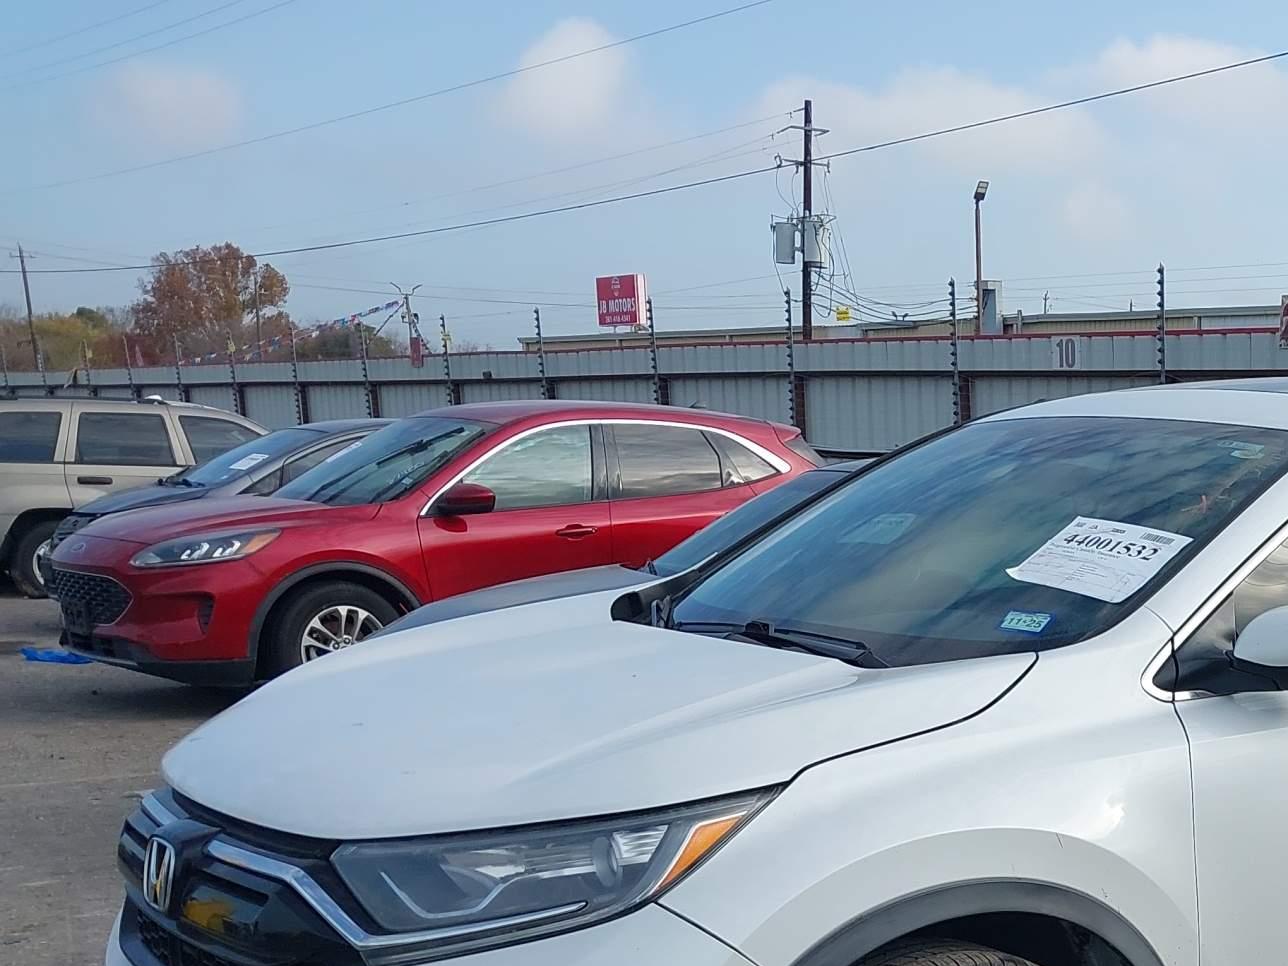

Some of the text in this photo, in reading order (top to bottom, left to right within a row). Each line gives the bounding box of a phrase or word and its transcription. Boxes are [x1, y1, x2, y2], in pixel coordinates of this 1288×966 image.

[600, 297, 636, 314] JB MOTORS
[1056, 338, 1076, 369] 10
[1064, 533, 1160, 561] 44001532
